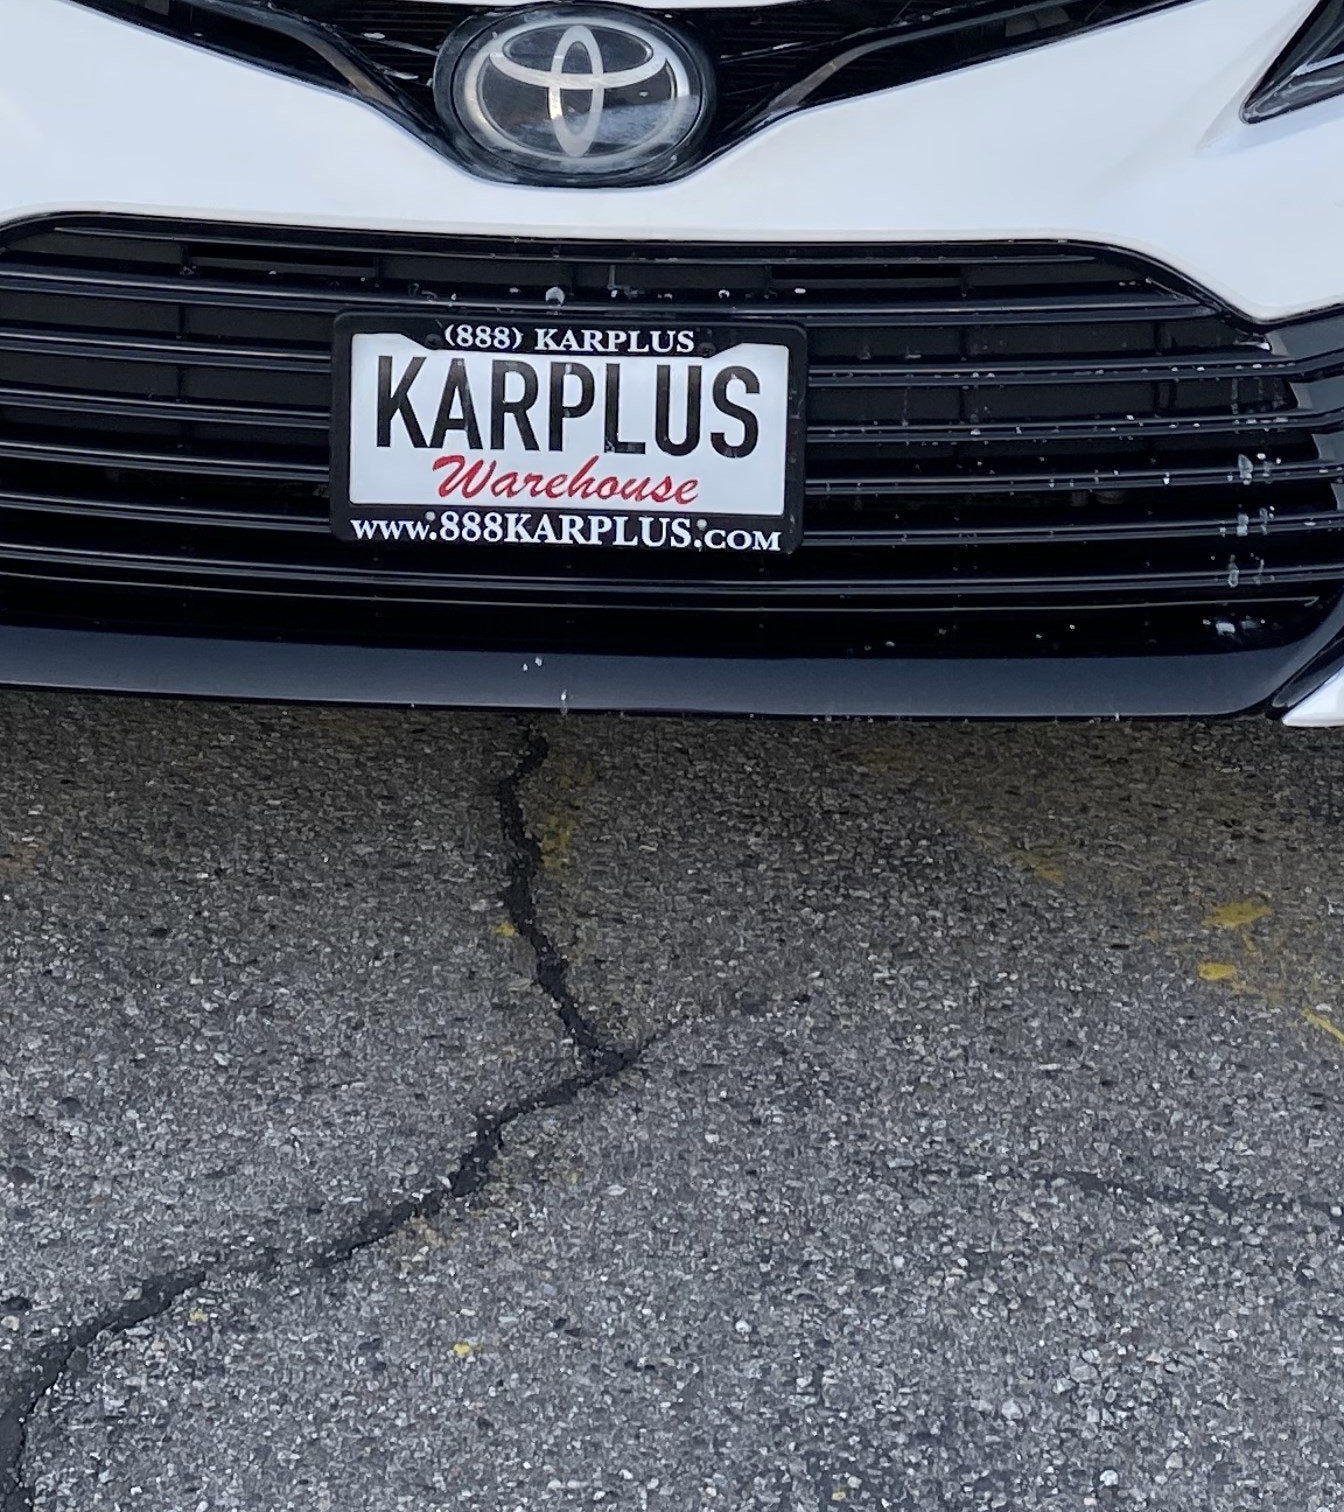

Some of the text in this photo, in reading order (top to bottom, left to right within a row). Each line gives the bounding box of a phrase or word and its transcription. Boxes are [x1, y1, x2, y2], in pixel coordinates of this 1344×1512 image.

[444, 324, 695, 354] (888) KARPLUS
[376, 354, 761, 459] KARPLUS
[432, 454, 699, 505] Warehouse
